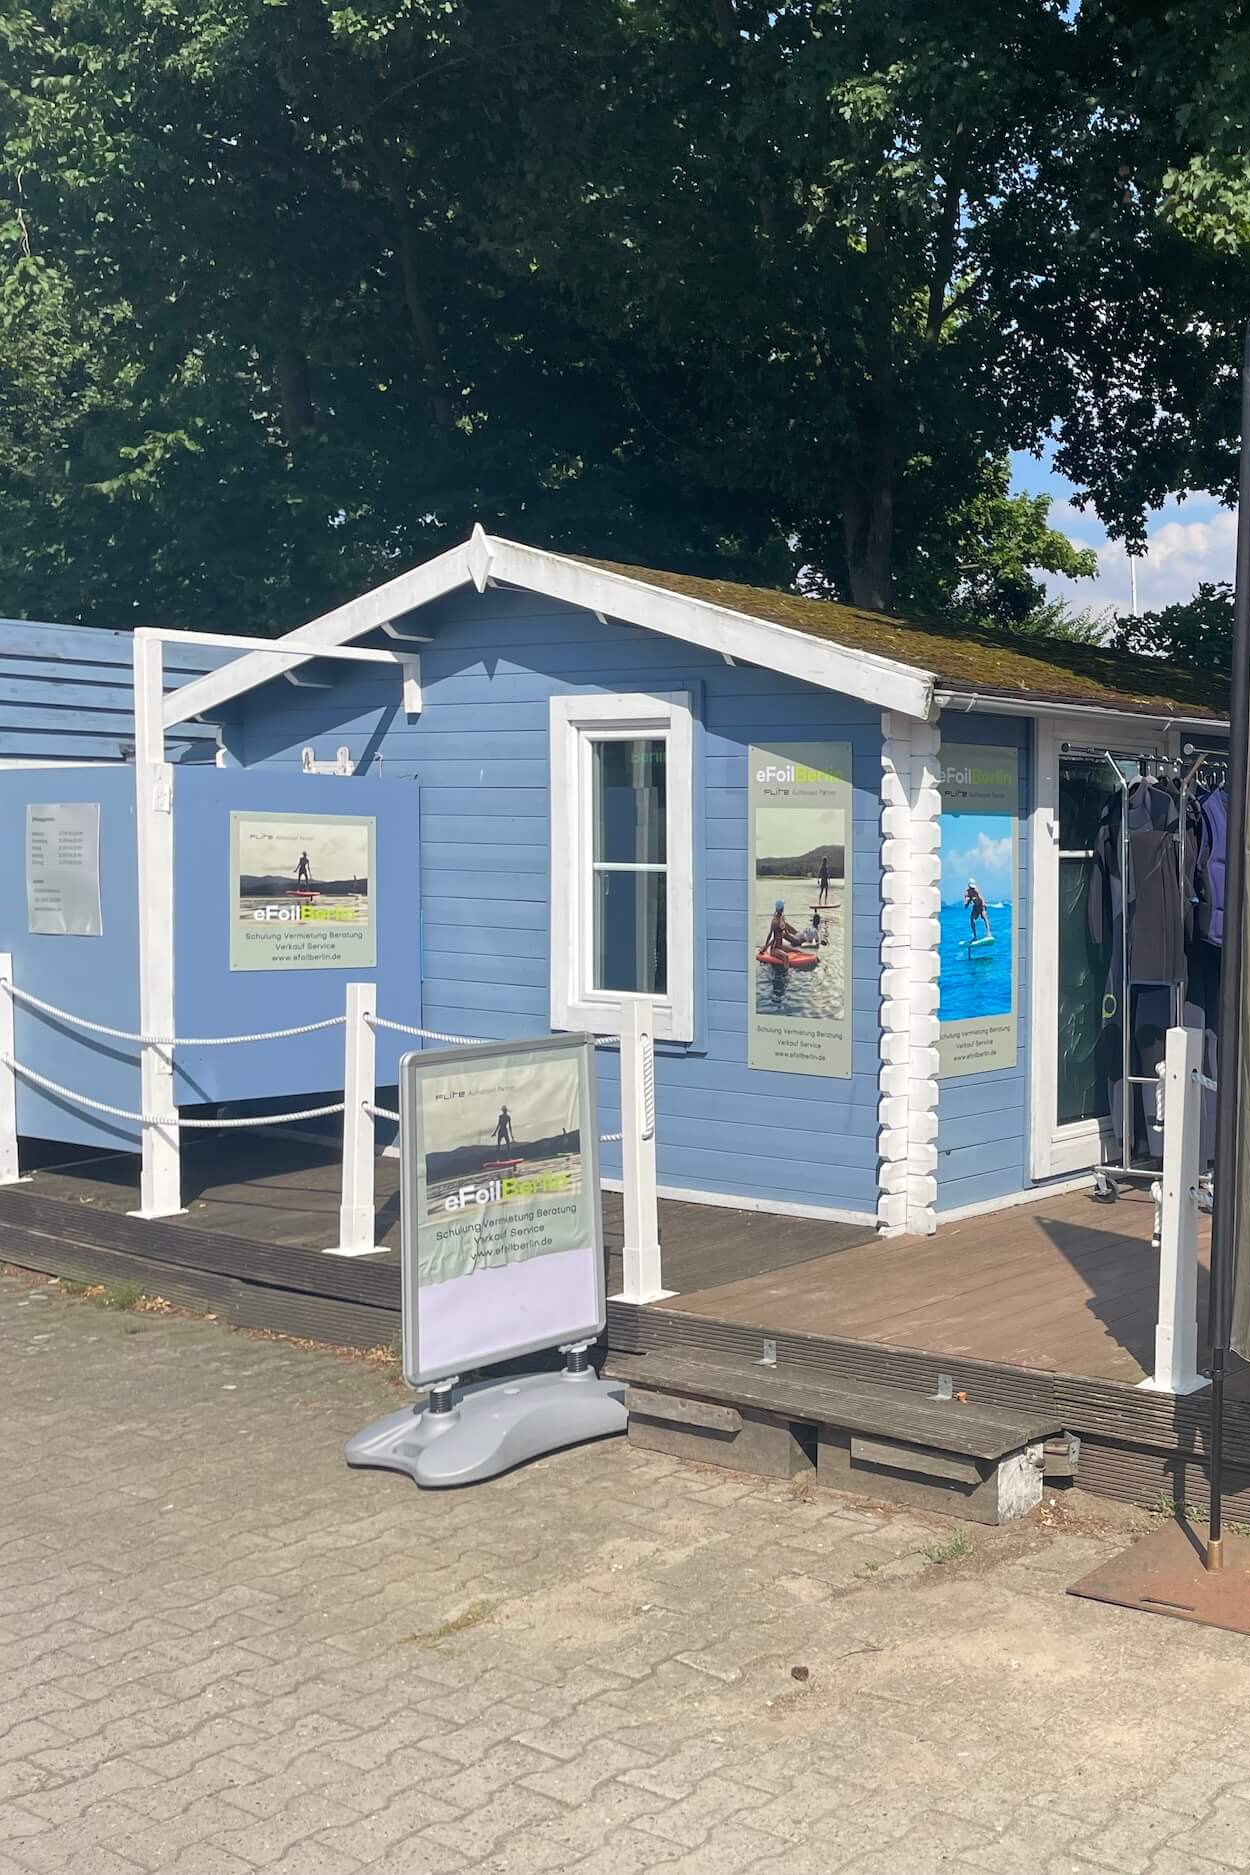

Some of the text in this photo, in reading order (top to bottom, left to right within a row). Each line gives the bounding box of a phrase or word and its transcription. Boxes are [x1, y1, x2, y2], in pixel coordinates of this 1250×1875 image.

[284, 932, 327, 940] Vermietung
[330, 931, 362, 939] Beratung
[275, 942, 335, 951] Verkauf Service
[445, 1170, 569, 1211] eFoilBerlin
[436, 1204, 577, 1241] Schulung Vermietung Beratung
[510, 1225, 545, 1237] Service
